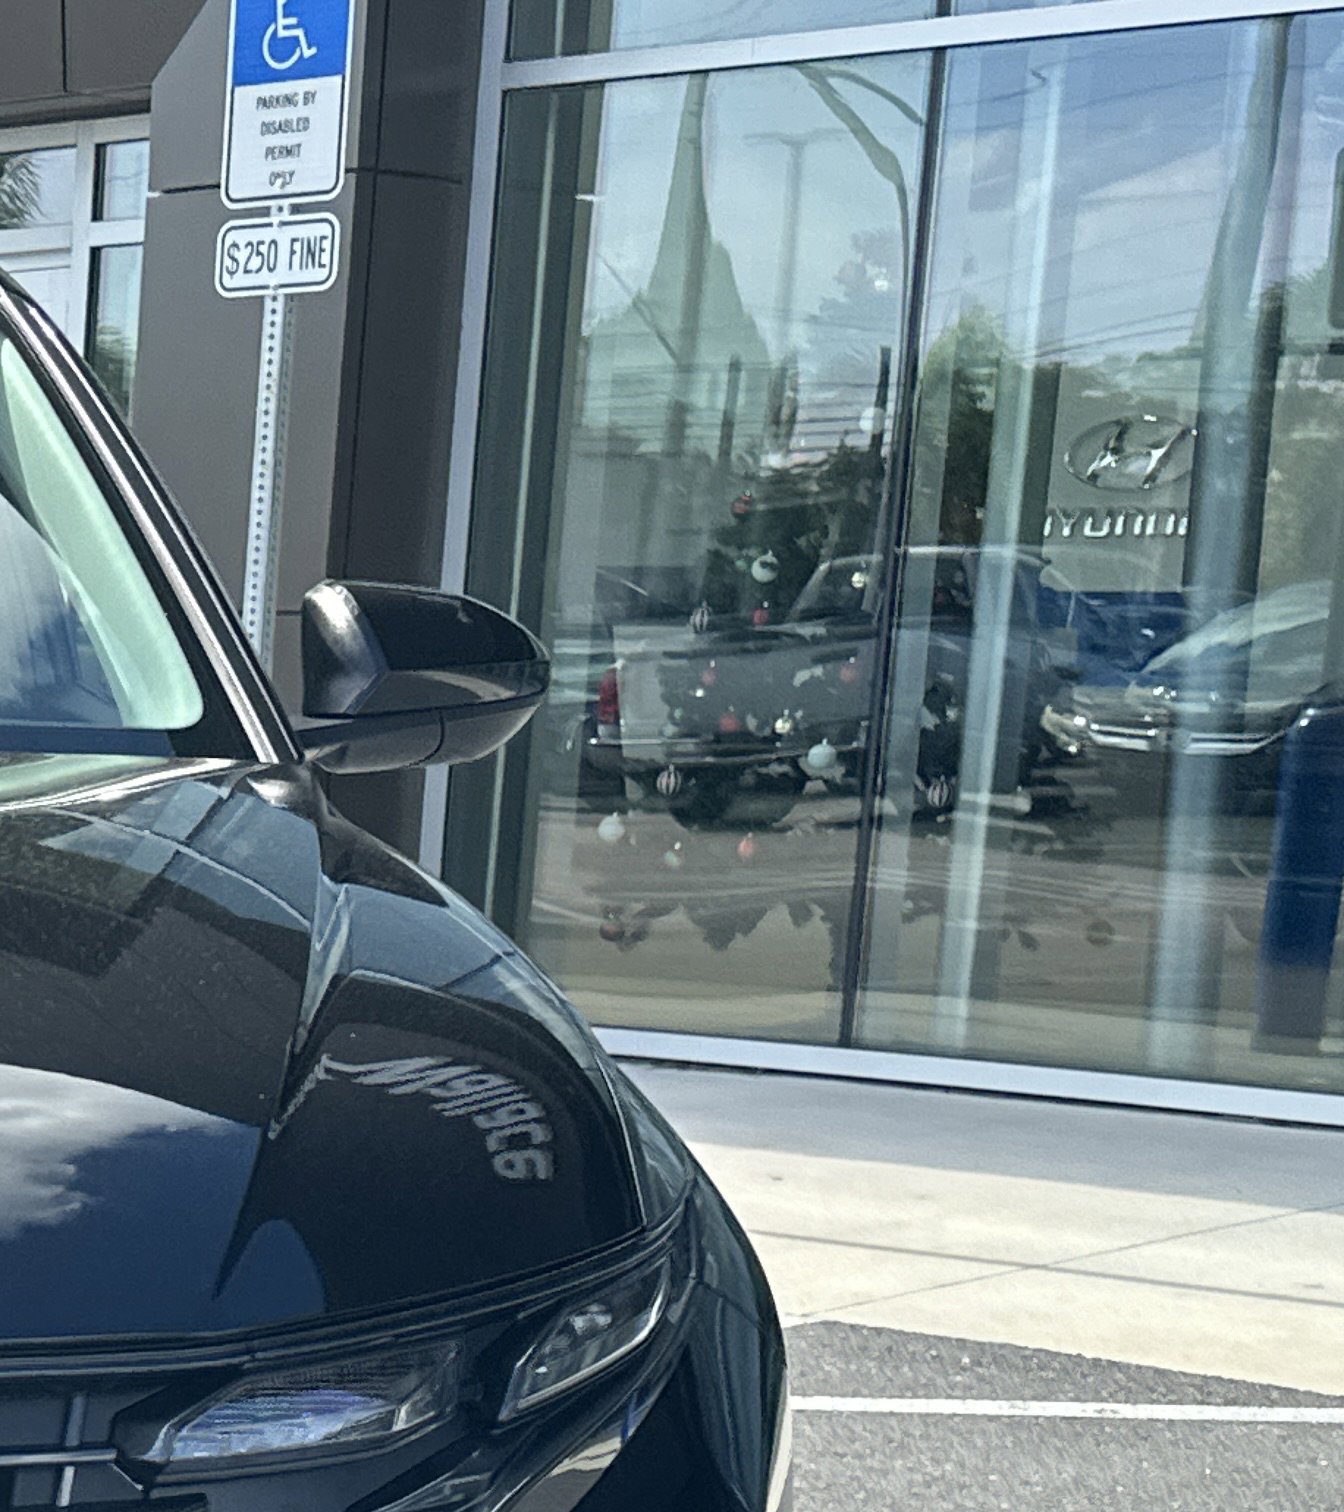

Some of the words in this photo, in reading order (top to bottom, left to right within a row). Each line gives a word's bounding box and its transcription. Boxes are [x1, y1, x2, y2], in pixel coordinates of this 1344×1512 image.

[256, 92, 300, 111] PARKING
[303, 90, 317, 106] BY
[260, 117, 310, 136] DISABLED
[264, 143, 302, 161] PERMIT
[225, 238, 278, 279] $250
[288, 235, 329, 271] FINE
